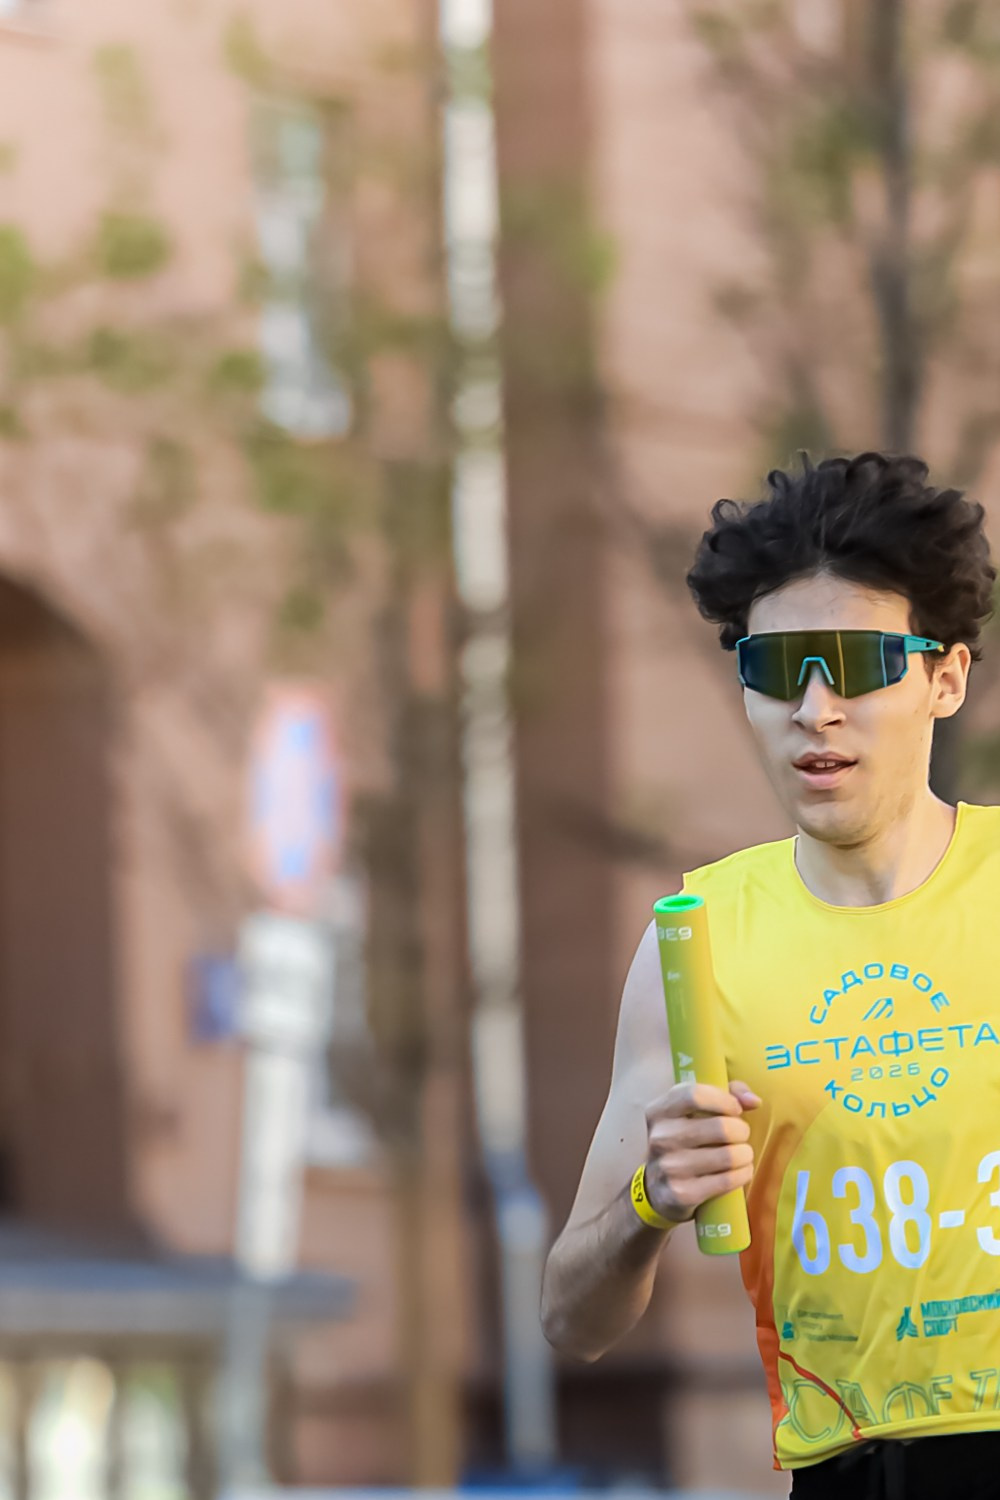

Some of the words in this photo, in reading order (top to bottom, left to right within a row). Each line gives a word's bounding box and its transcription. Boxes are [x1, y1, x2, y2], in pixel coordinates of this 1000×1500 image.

[809, 962, 950, 1025] САДОВОЕ
[764, 1022, 1000, 1071] ЭСТАФЕТА
[850, 1062, 921, 1082] 2026
[824, 1066, 950, 1119] КОЛЬЦО
